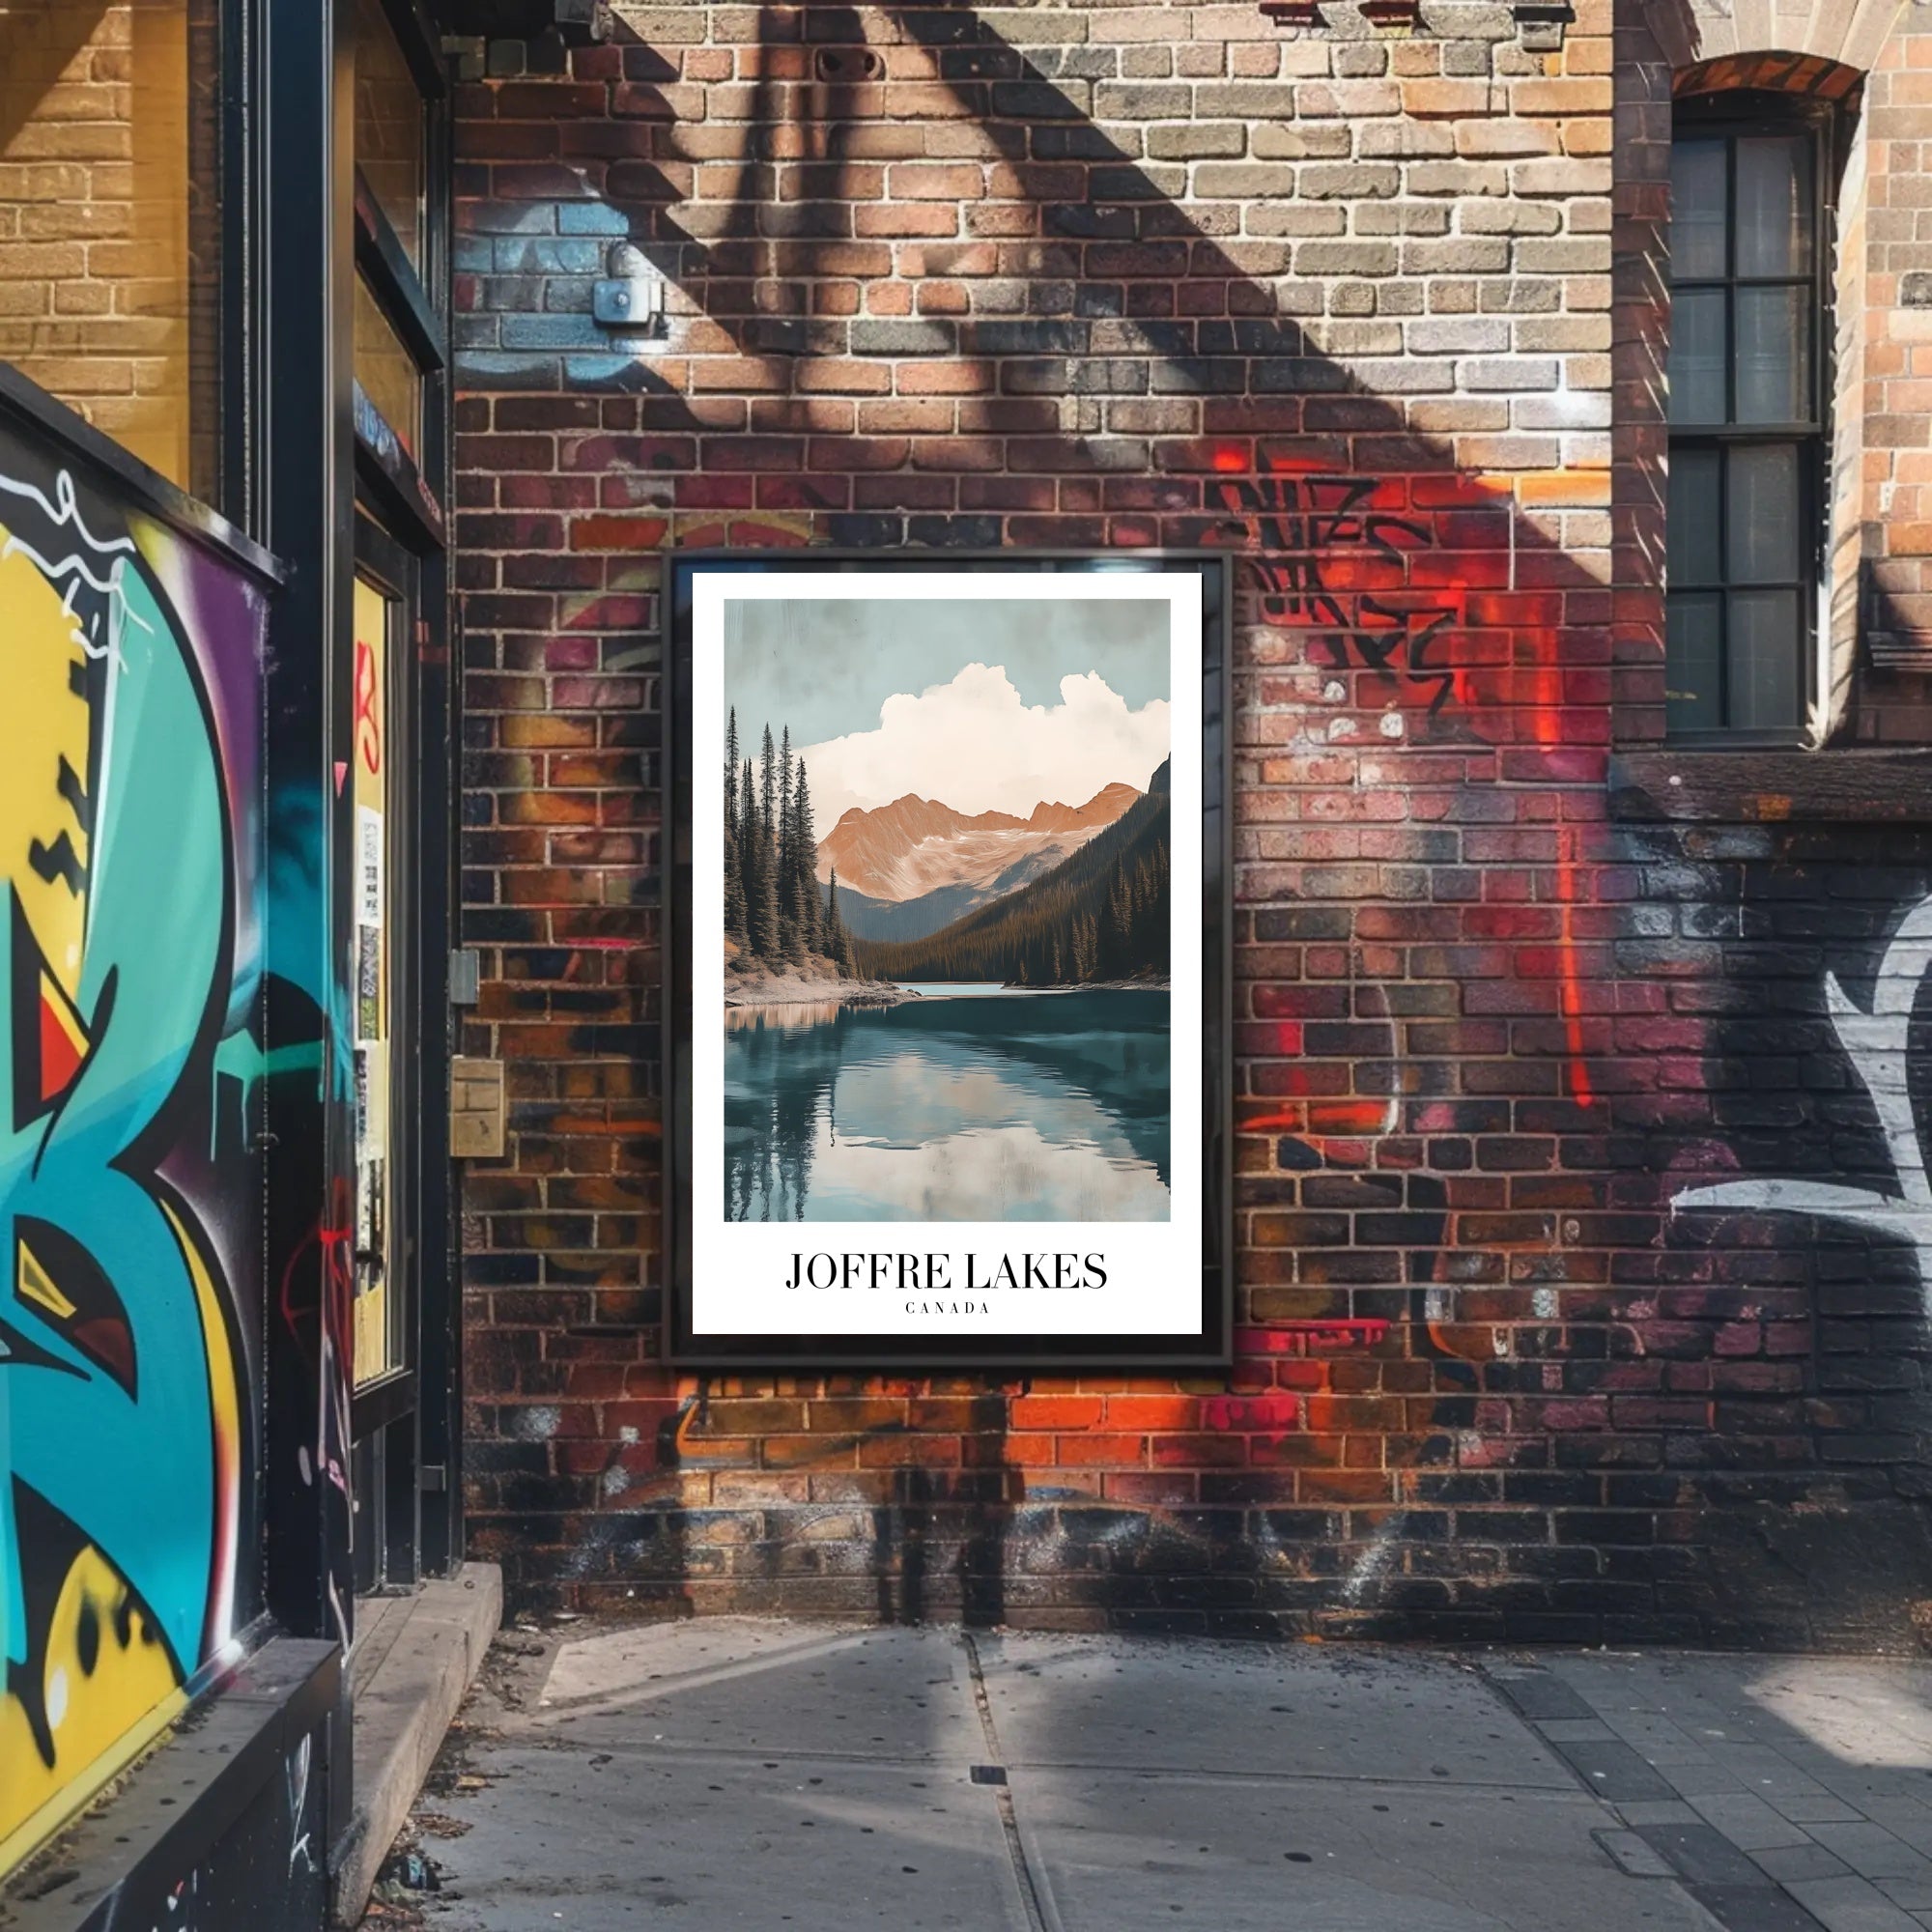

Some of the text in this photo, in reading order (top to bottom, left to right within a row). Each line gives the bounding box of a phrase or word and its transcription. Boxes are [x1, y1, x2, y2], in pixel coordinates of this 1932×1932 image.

[785, 1252, 1108, 1290] JOFFRE LAKES
[905, 1301, 989, 1315] CANADA
